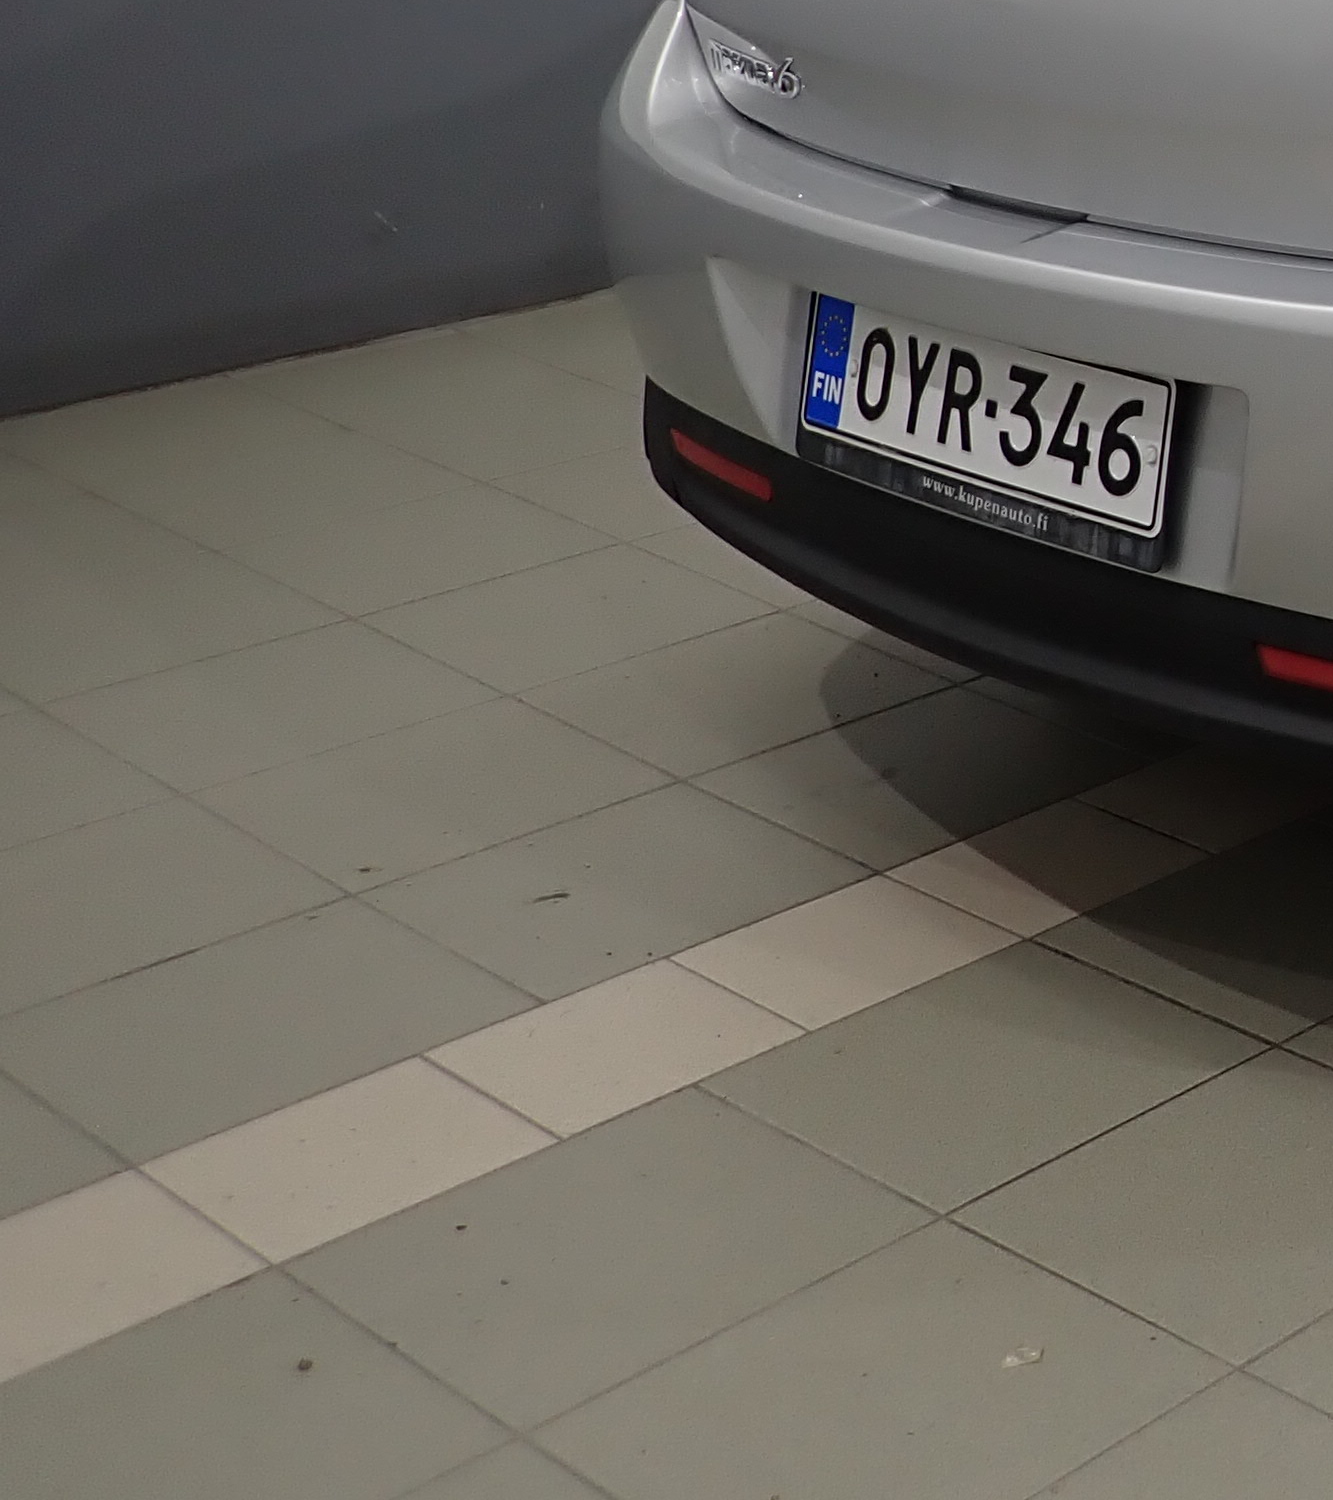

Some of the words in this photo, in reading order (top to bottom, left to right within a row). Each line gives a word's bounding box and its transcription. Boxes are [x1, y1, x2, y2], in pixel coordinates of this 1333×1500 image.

[811, 371, 842, 405] FIN
[856, 327, 1145, 496] OYR-346
[922, 474, 1049, 532] www.kupenauto.fi
